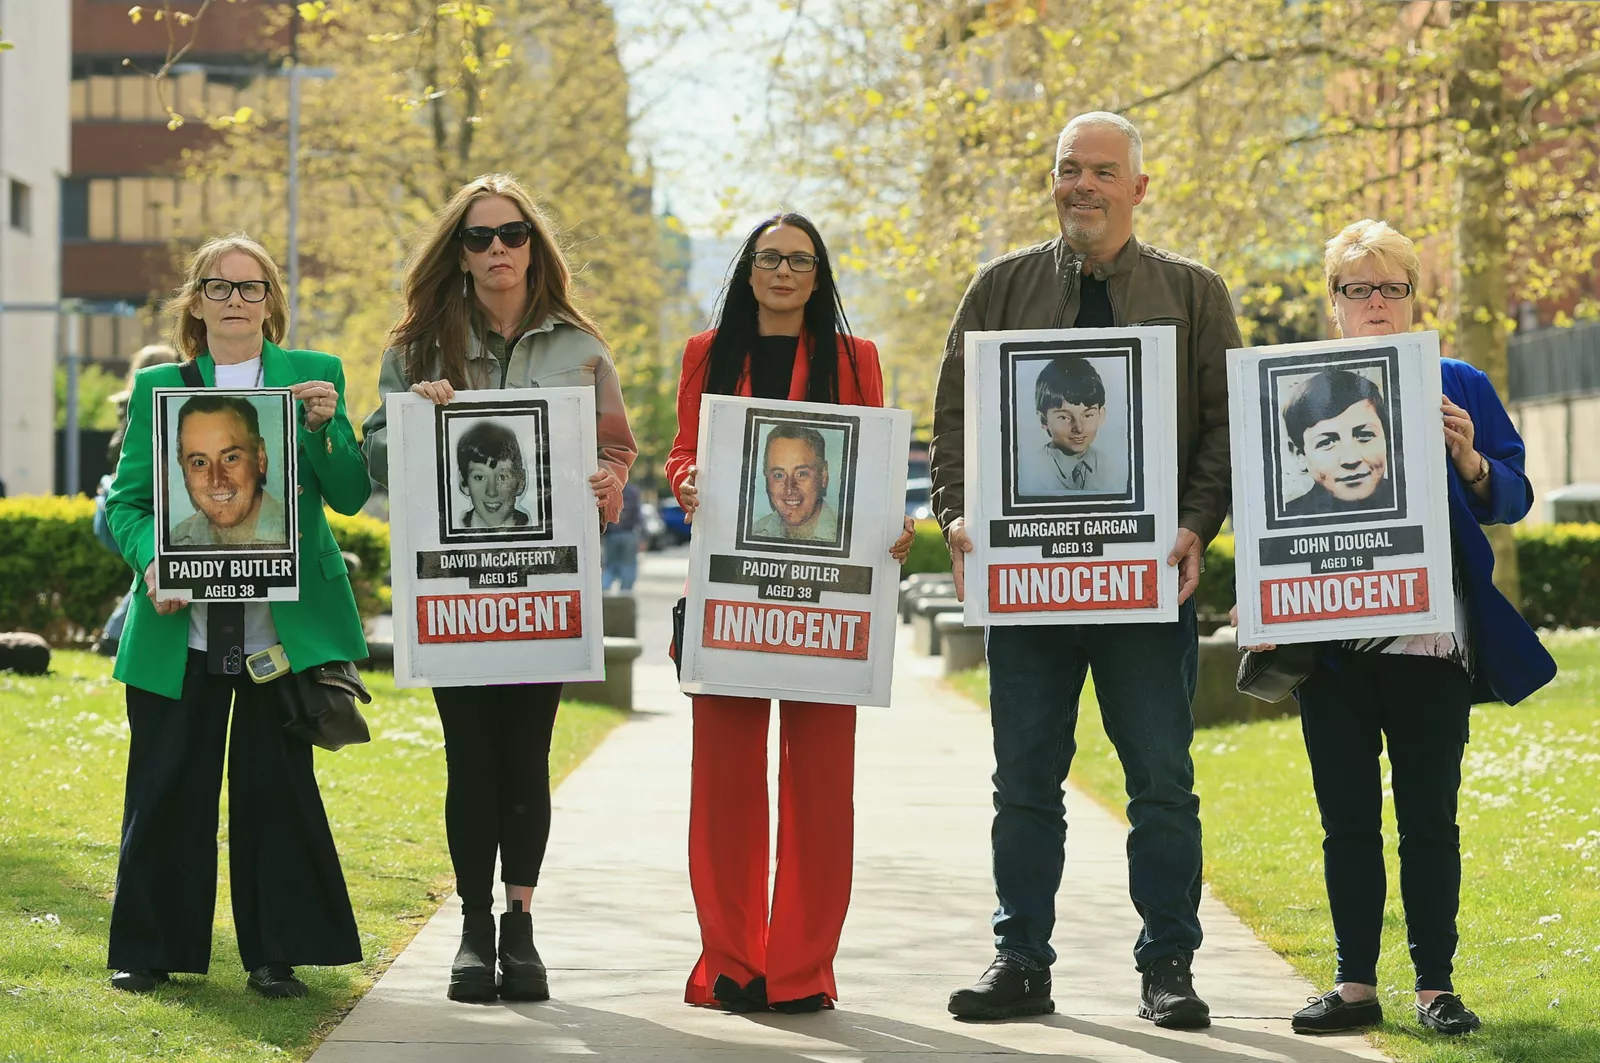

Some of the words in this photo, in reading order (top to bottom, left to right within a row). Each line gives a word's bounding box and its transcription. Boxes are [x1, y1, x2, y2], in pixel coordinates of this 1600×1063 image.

[1008, 521, 1080, 538] MARGARET
[1083, 518, 1138, 535] GARGAN
[1051, 543, 1079, 555] AGED
[1081, 542, 1094, 554] 13
[1290, 535, 1330, 556] JOHN
[1334, 531, 1393, 551] DOUGAL
[169, 560, 225, 579] PADDY
[230, 559, 292, 578] BUTLER
[440, 553, 477, 569] DAVID
[480, 551, 556, 567] McCAFFERTY
[1320, 558, 1347, 570] AGED
[1350, 556, 1363, 568] 16
[479, 572, 504, 585] AGED
[505, 571, 518, 583] 15
[742, 560, 787, 579] PADDY
[791, 564, 840, 583] BUTLER
[204, 585, 236, 598] AGED
[239, 585, 255, 598] 38
[765, 584, 794, 598] AGED
[797, 586, 812, 599] 38
[999, 564, 1147, 605] INNOCENT
[1270, 572, 1419, 616] INNOCENT
[426, 596, 572, 636] INNOCENT
[712, 604, 861, 651] INNOCENT
